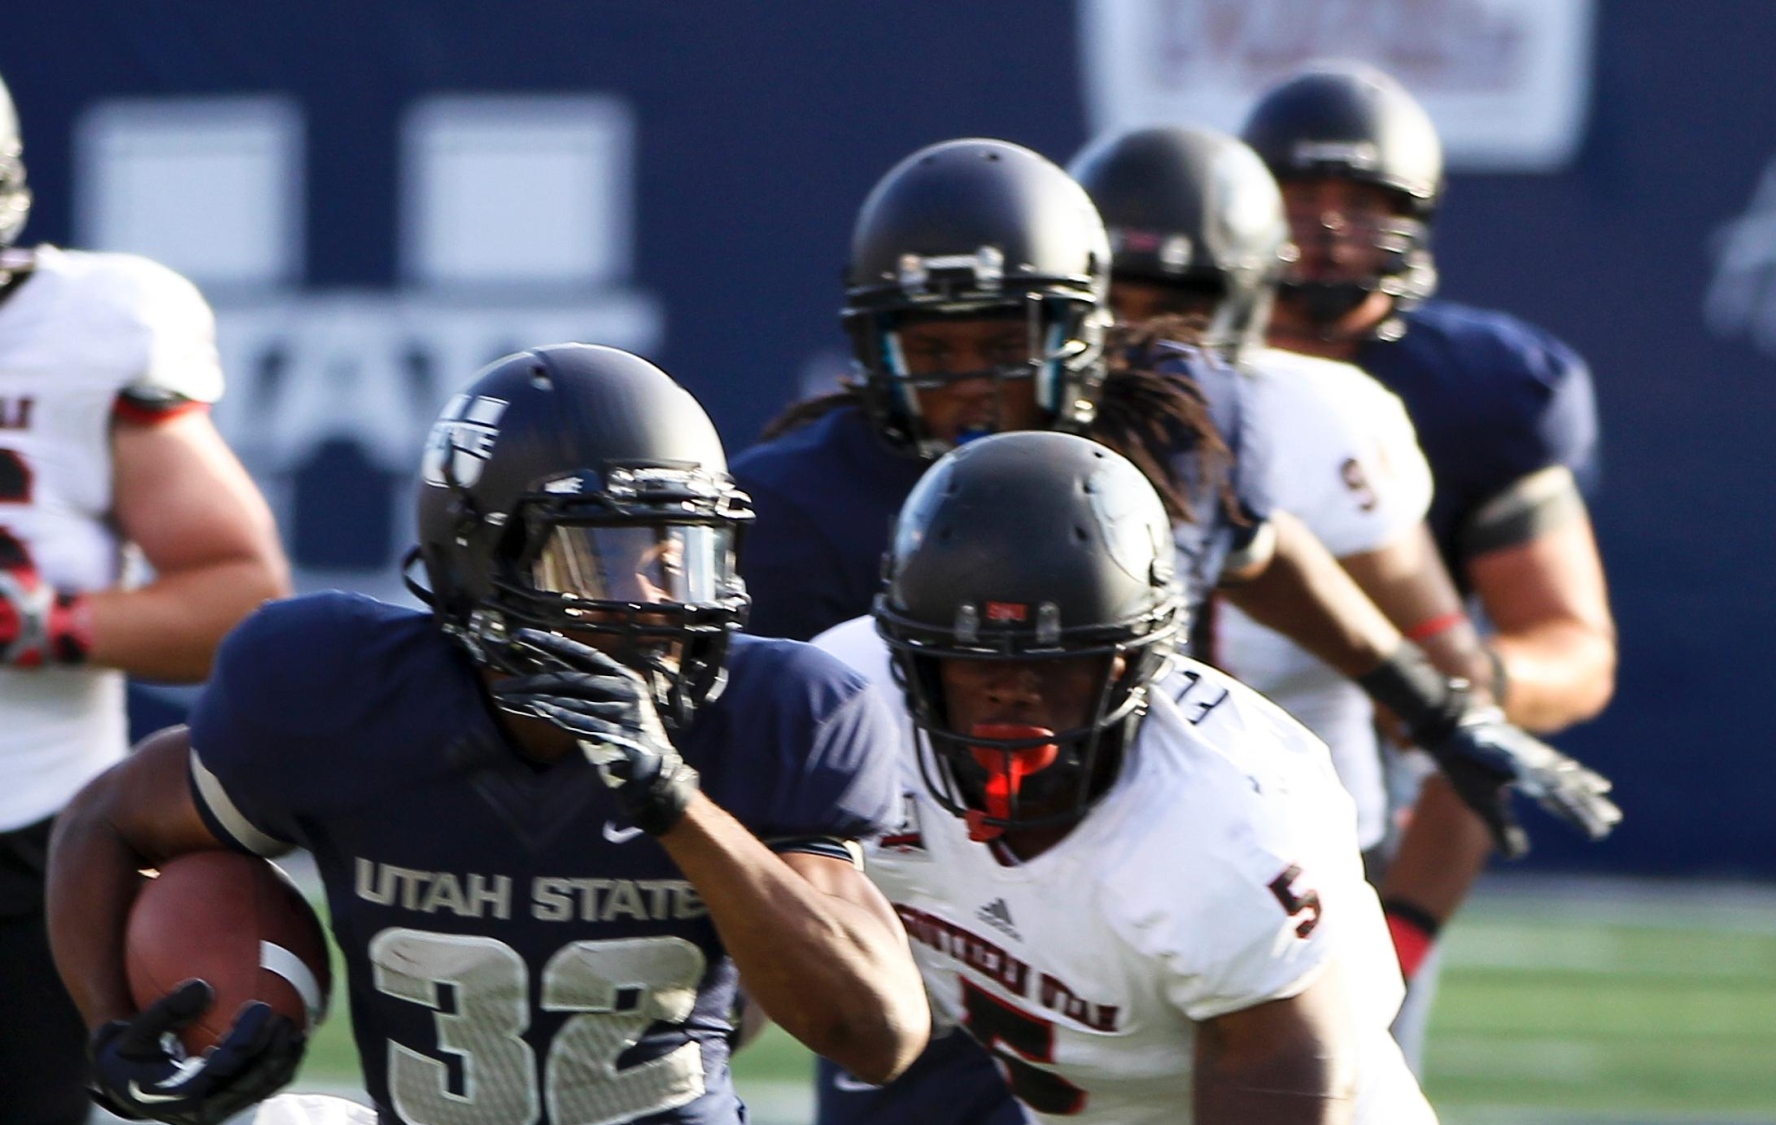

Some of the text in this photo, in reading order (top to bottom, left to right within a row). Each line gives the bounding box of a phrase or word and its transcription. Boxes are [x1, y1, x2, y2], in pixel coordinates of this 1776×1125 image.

[355, 856, 710, 922] UTAH STATE
[1267, 864, 1322, 939] 5
[958, 973, 1090, 1116] 5
